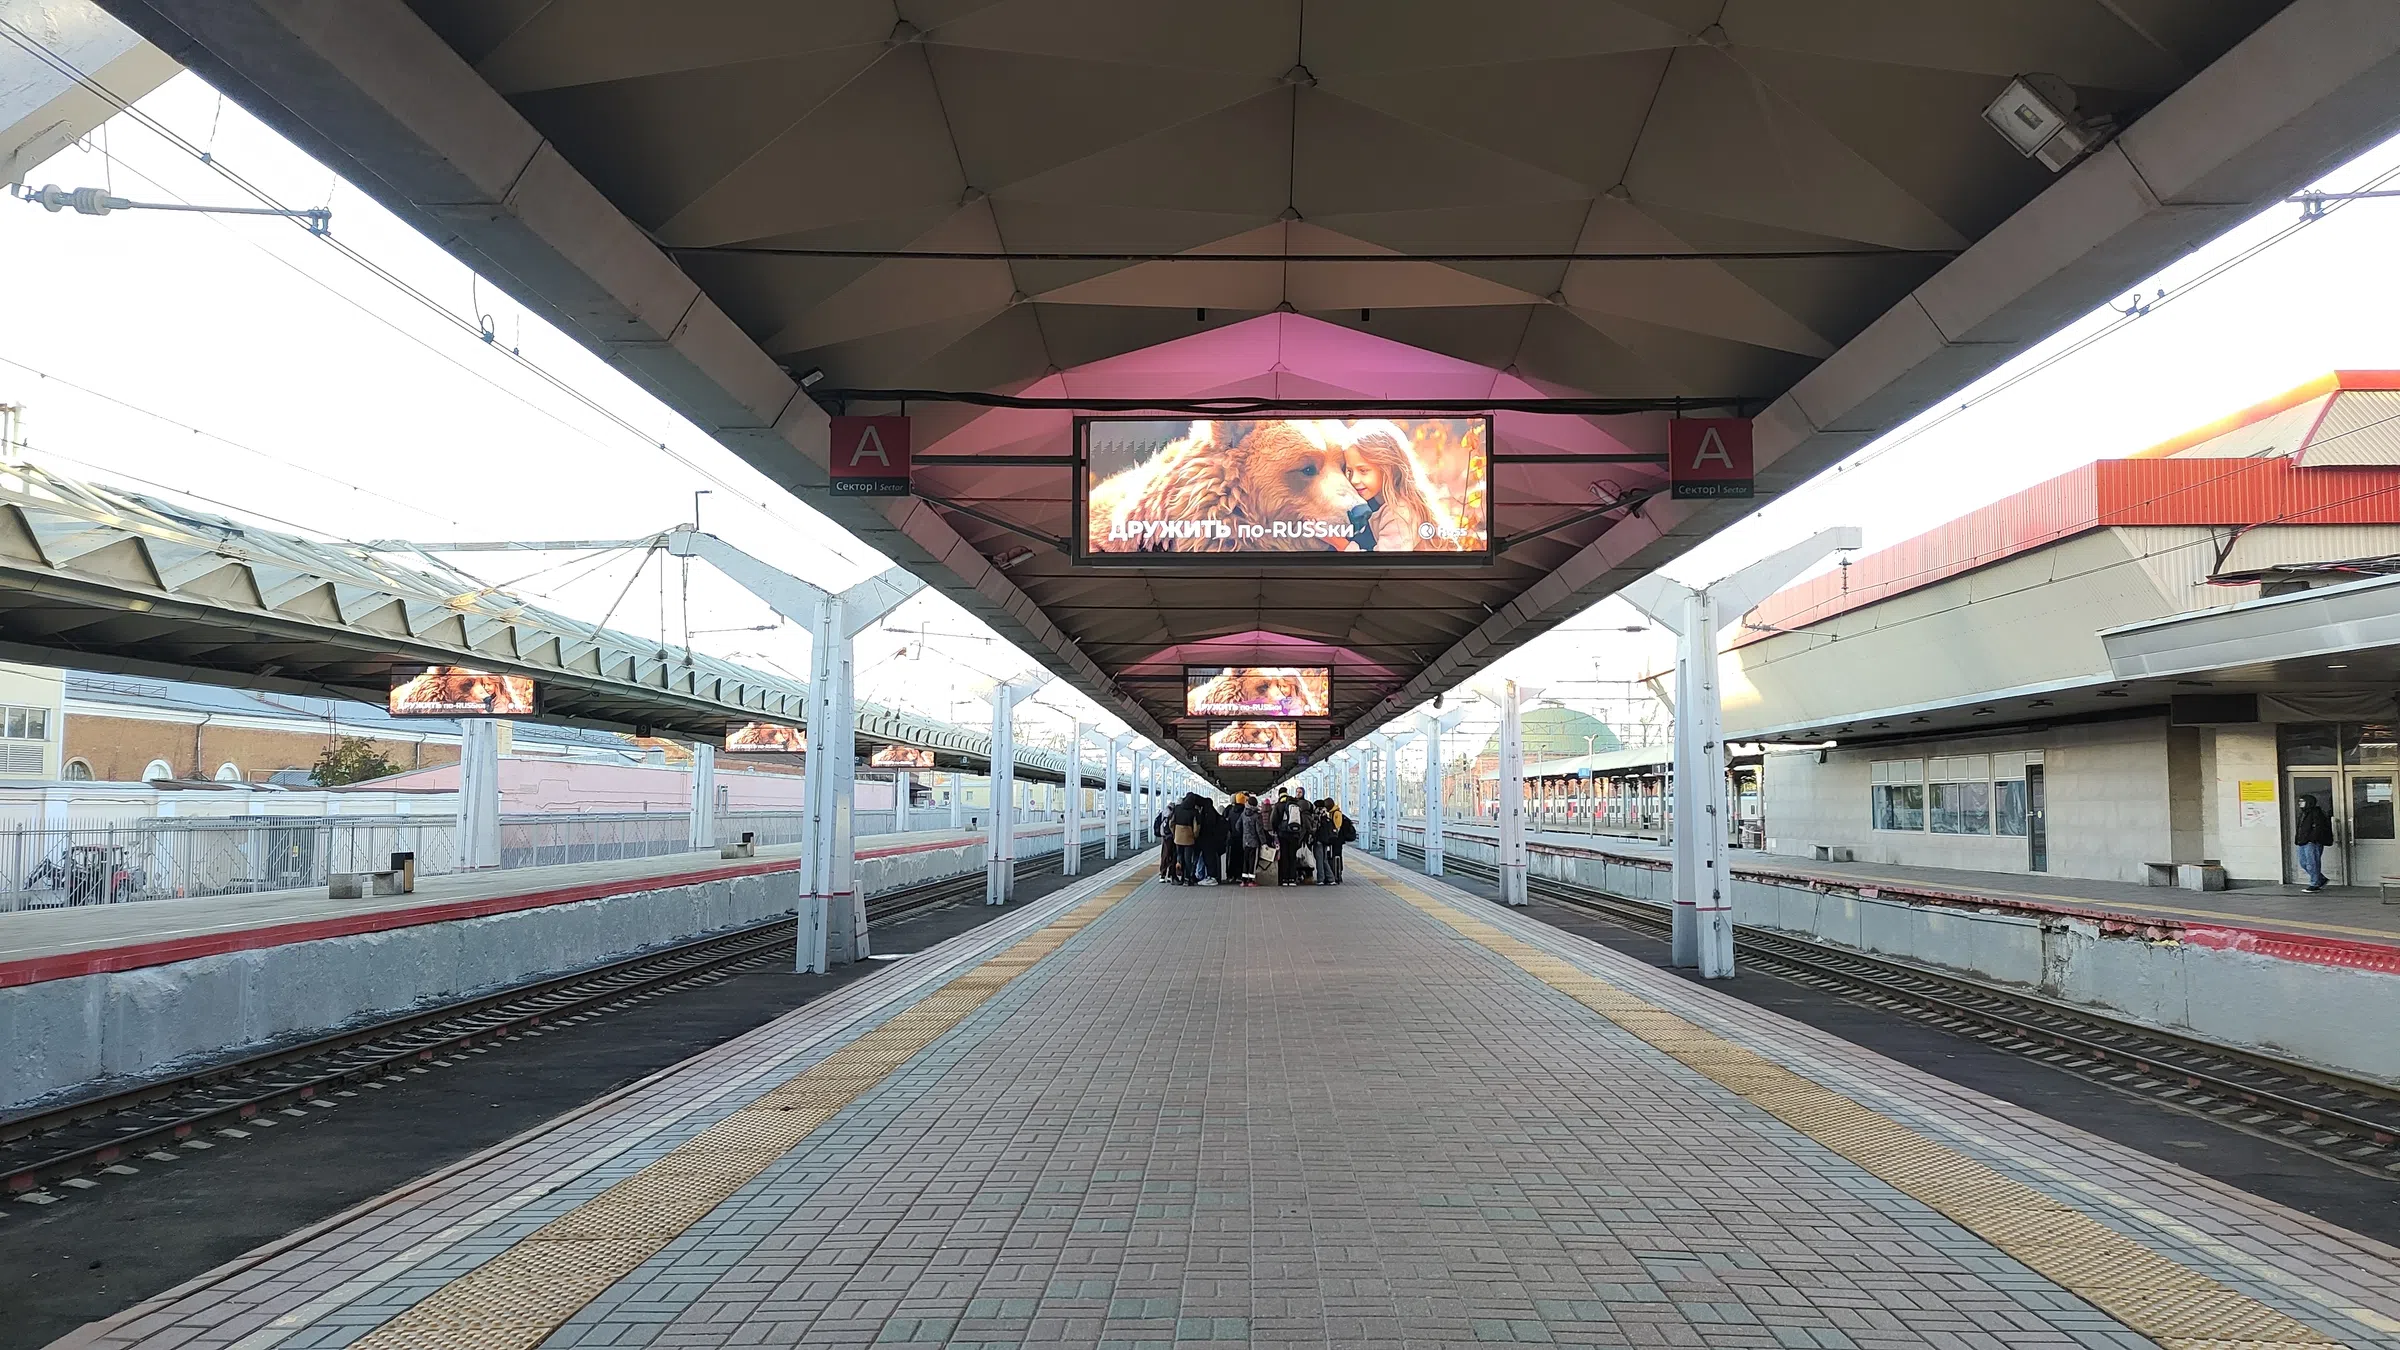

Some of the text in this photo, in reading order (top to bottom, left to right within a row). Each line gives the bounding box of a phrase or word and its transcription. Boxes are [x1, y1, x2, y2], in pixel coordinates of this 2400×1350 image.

[836, 481, 904, 493] Сектор Sector
[1678, 485, 1747, 496] Сектор Sector
[1108, 519, 1354, 542] ДРУЖИТЬ по-RUSSки
[1334, 726, 1341, 736] 3
